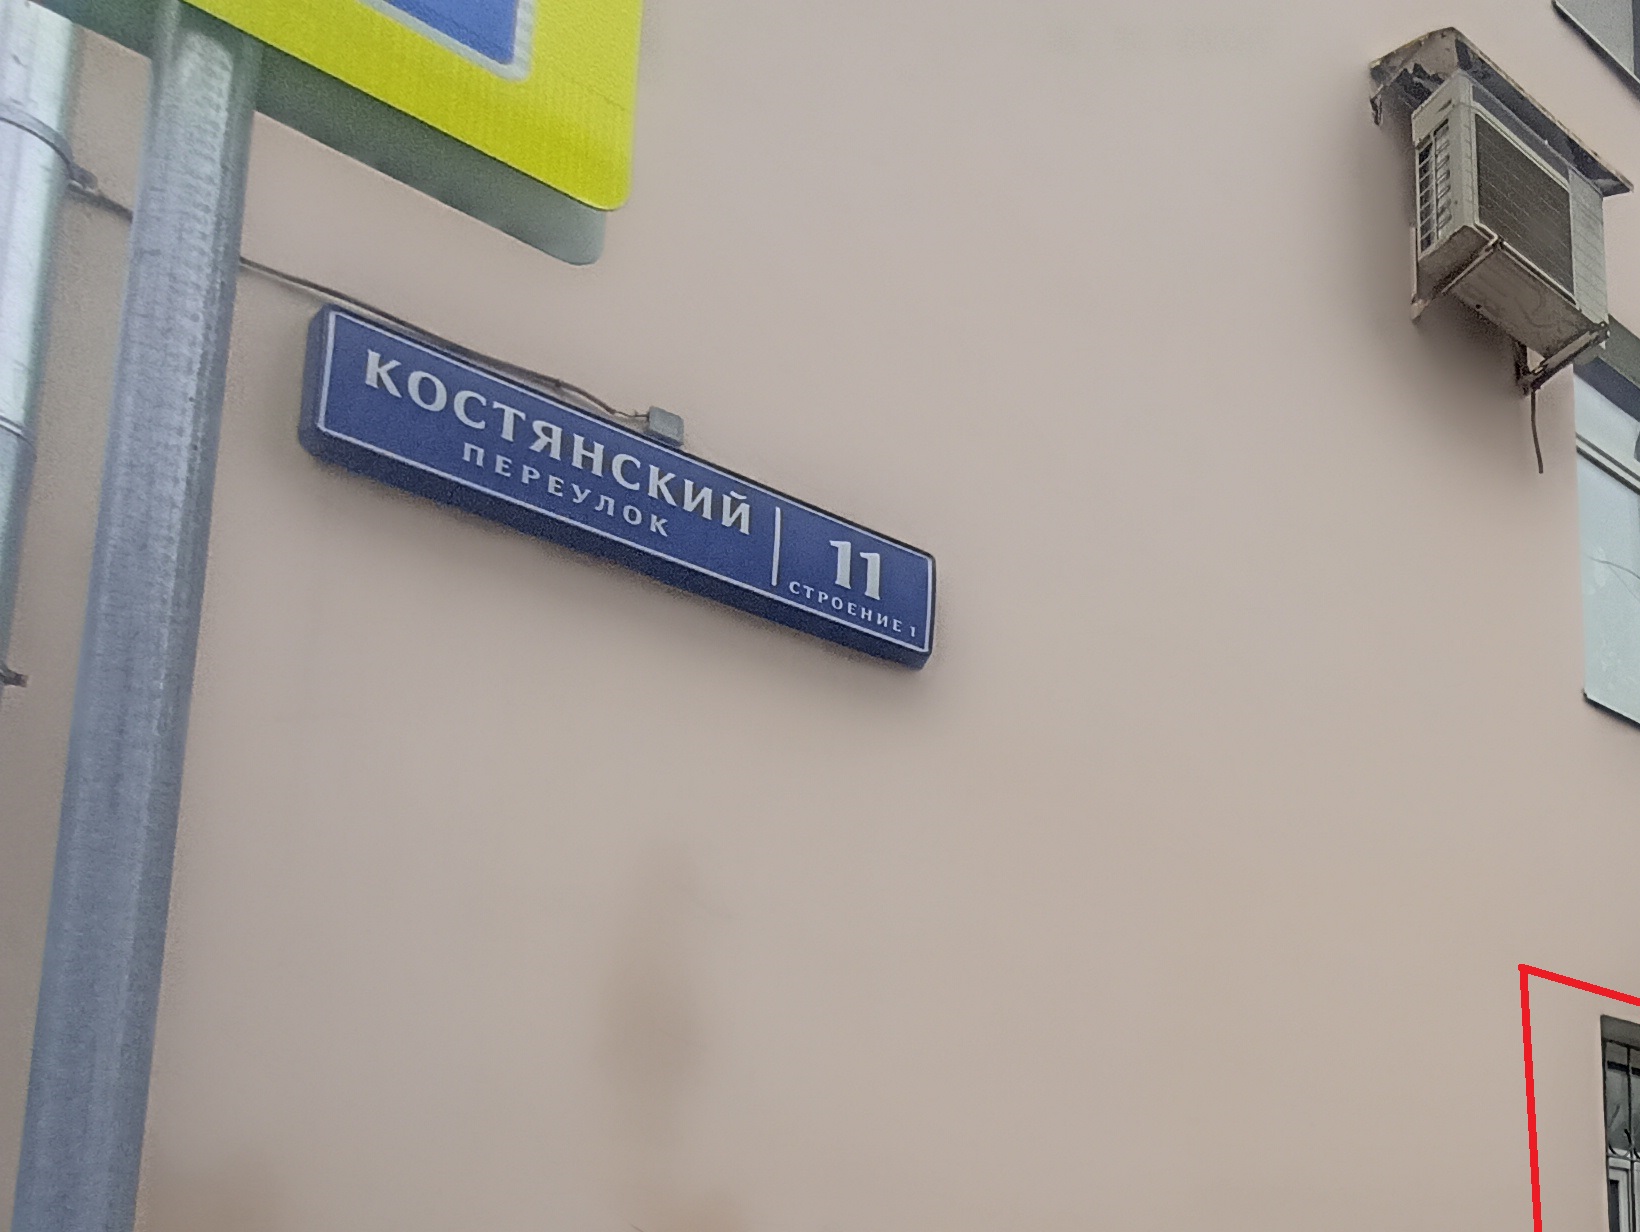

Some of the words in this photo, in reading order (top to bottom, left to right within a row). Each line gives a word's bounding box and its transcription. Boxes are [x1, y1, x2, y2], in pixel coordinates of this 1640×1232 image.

[364, 348, 752, 535] КОСТЯНСКИЙ
[462, 441, 670, 538] ПЕРЕУЛОК
[789, 581, 903, 632] СТРОЕНИЕ
[910, 625, 917, 638] 1
[829, 540, 881, 601] 11
